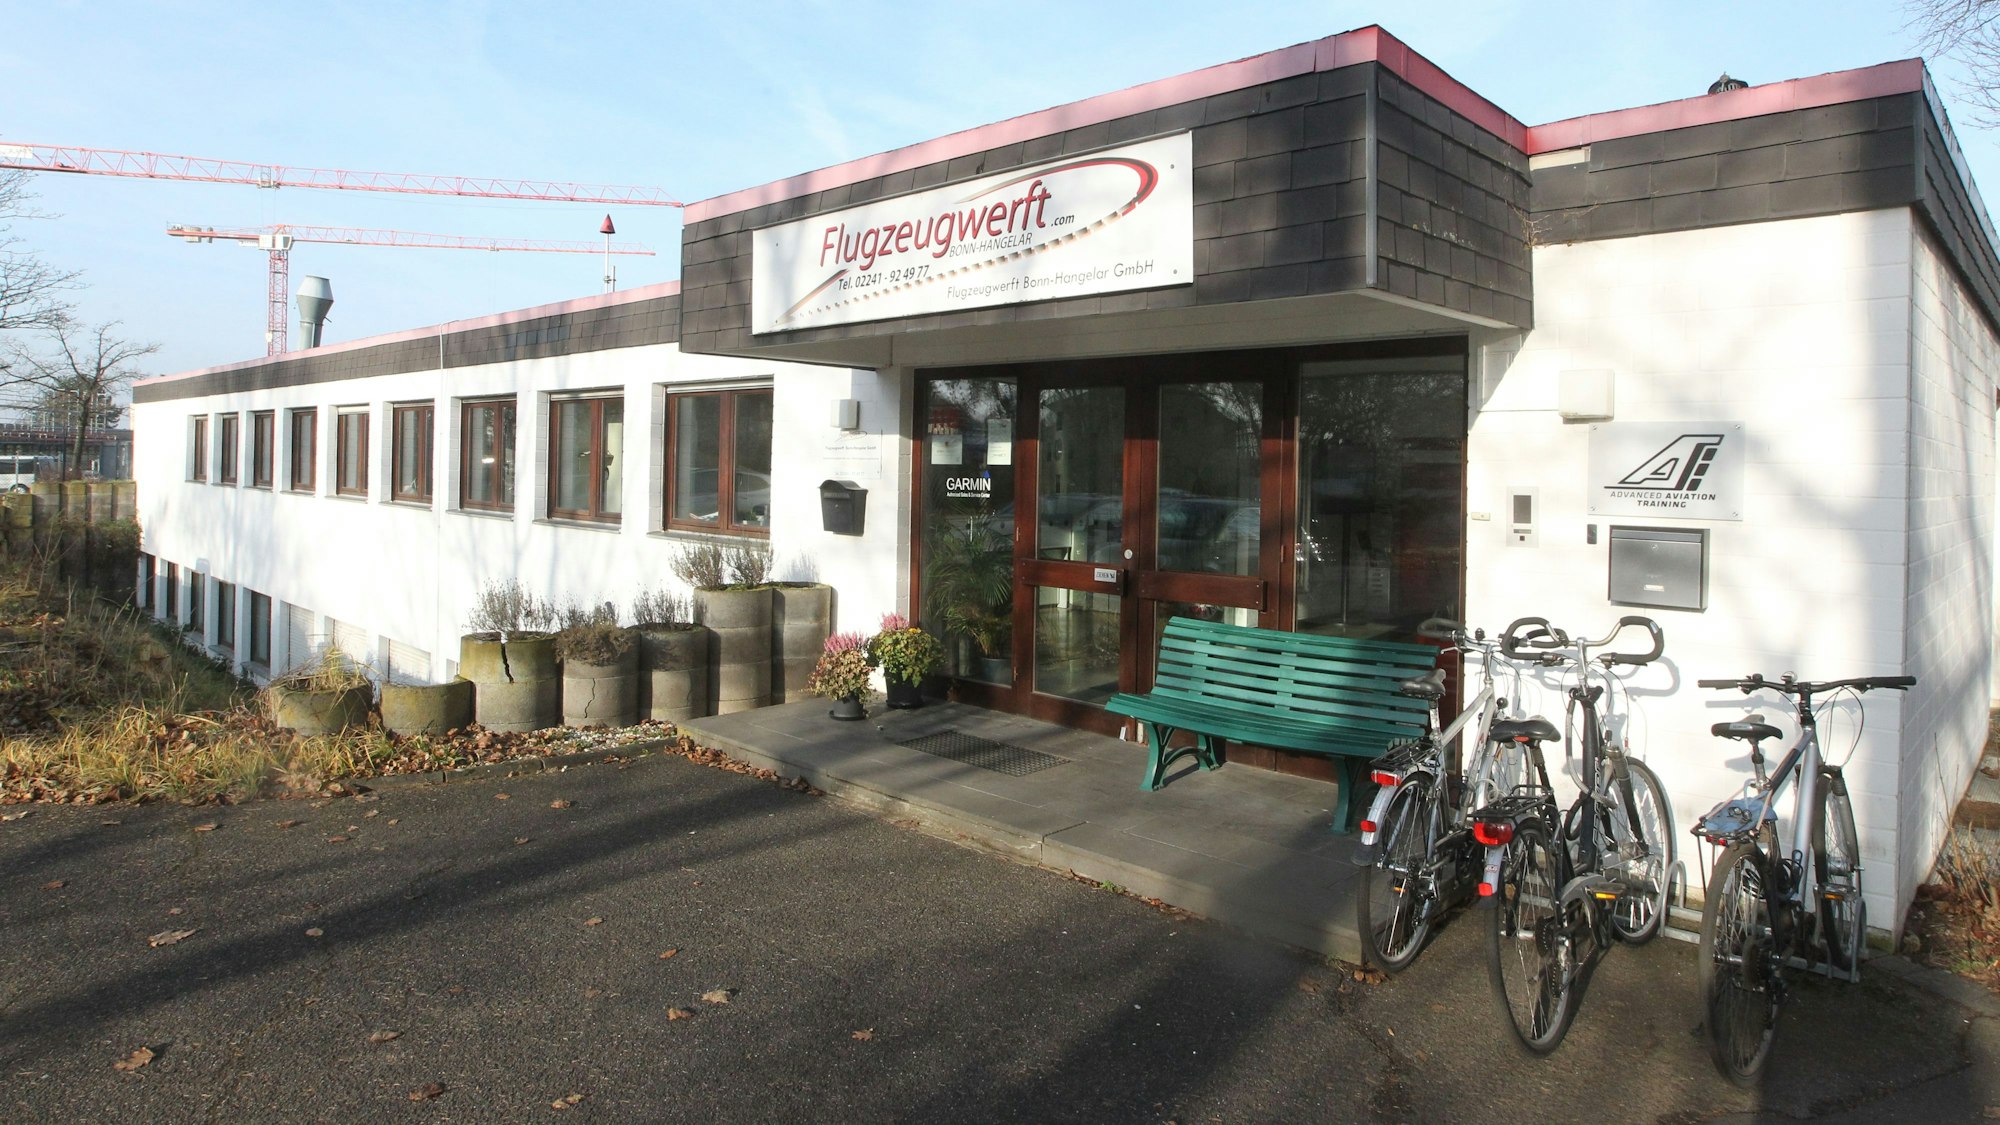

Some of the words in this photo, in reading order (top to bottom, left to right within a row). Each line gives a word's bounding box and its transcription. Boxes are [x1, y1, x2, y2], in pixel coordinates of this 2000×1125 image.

[820, 179, 1052, 271] Flugzeugwerft
[949, 232, 1033, 258] BONN-HANGELAR
[838, 276, 853, 291] Tel.
[855, 272, 882, 288] 02241
[889, 269, 901, 283] 92
[903, 267, 916, 281] 49
[917, 265, 930, 278] 77
[947, 277, 1020, 300] Flugzeugwerft
[1023, 266, 1109, 289] Bonn-Hangelar
[1113, 259, 1154, 278] GmbH
[946, 477, 991, 491] GARMIN
[1610, 491, 1662, 499] ADVANCED
[1665, 492, 1716, 501] AVIATION
[1637, 500, 1686, 508] TRAINING
